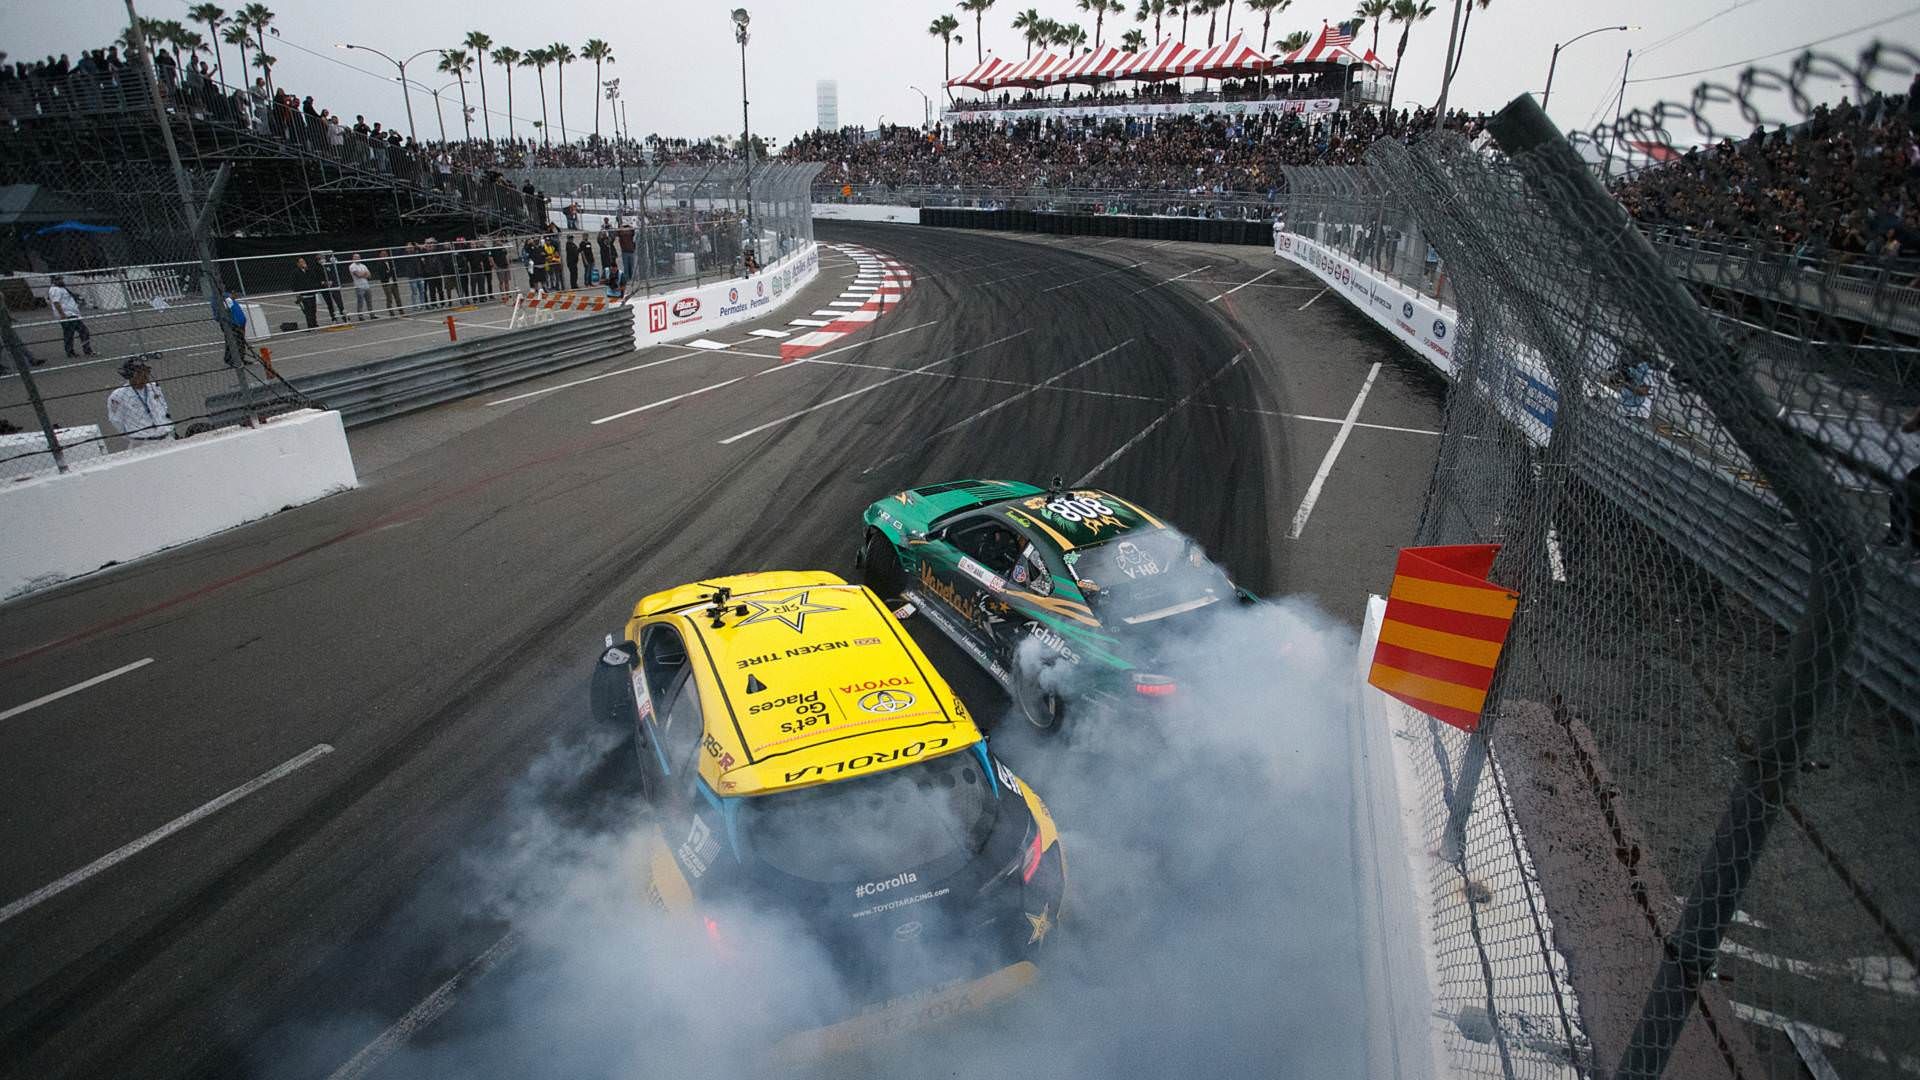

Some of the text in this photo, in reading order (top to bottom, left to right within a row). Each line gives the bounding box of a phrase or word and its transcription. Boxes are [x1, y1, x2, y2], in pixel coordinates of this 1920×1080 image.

[1258, 101, 1284, 112] FORMULA
[651, 303, 666, 331] FD
[719, 303, 748, 317] Permatex
[1047, 497, 1114, 522] 808
[785, 639, 848, 659] NEXEN
[1024, 620, 1080, 664] Achilles
[736, 653, 782, 670] TIRE
[838, 676, 913, 696] TOYOTA
[748, 690, 819, 717] Places
[795, 701, 826, 716] Go
[780, 711, 831, 735] Let's
[783, 737, 949, 783] COROLLA
[855, 872, 918, 898] #Corolla
[852, 887, 950, 918] www.TOYOTARACING.com
